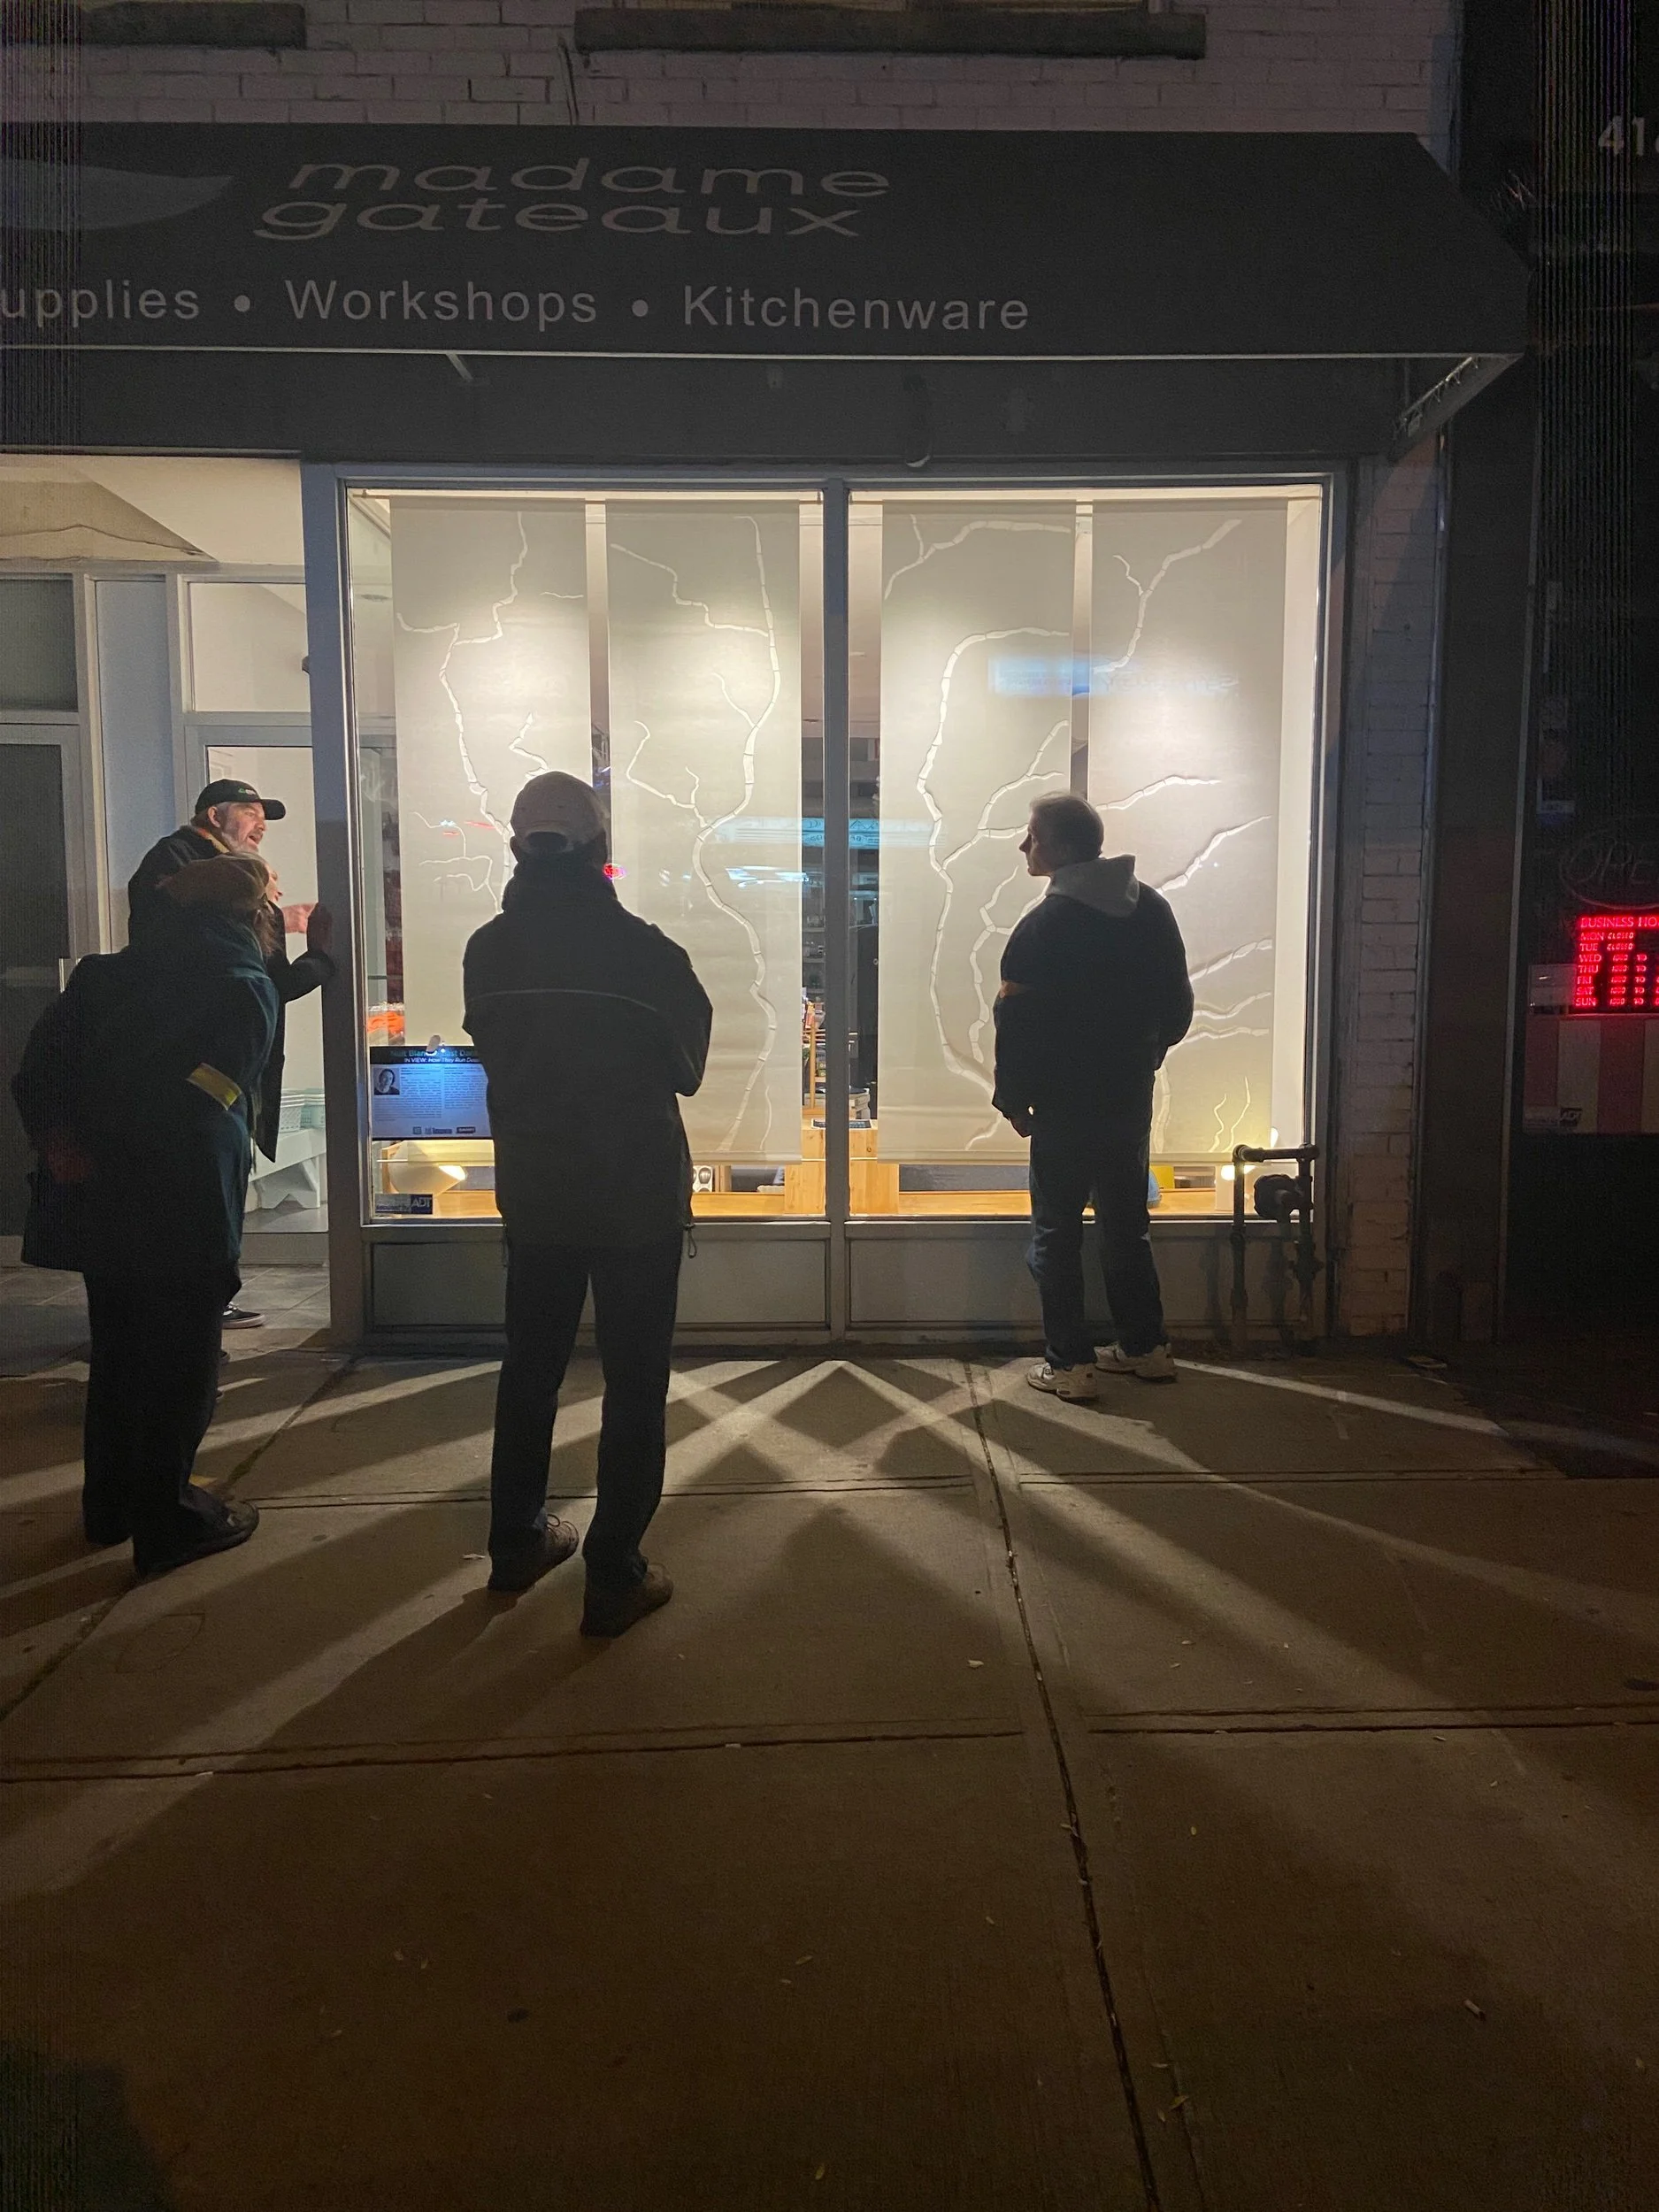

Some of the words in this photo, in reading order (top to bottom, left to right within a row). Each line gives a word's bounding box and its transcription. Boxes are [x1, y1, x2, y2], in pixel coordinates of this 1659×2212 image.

[1597, 115, 1659, 157] 41
[288, 157, 891, 196] madame
[252, 197, 862, 241] gateaux
[284, 279, 597, 331] Workshops
[683, 284, 1030, 330] Kitchenware
[1579, 917, 1635, 928] BUSINESS
[1580, 932, 1605, 941] MON
[1579, 943, 1599, 952] TUE
[1578, 954, 1602, 963] WED
[1578, 964, 1599, 973] THU
[1577, 976, 1592, 985] FRI
[1576, 987, 1594, 995] SAT
[1575, 997, 1596, 1006] SUN
[411, 1196, 432, 1208] ADT
